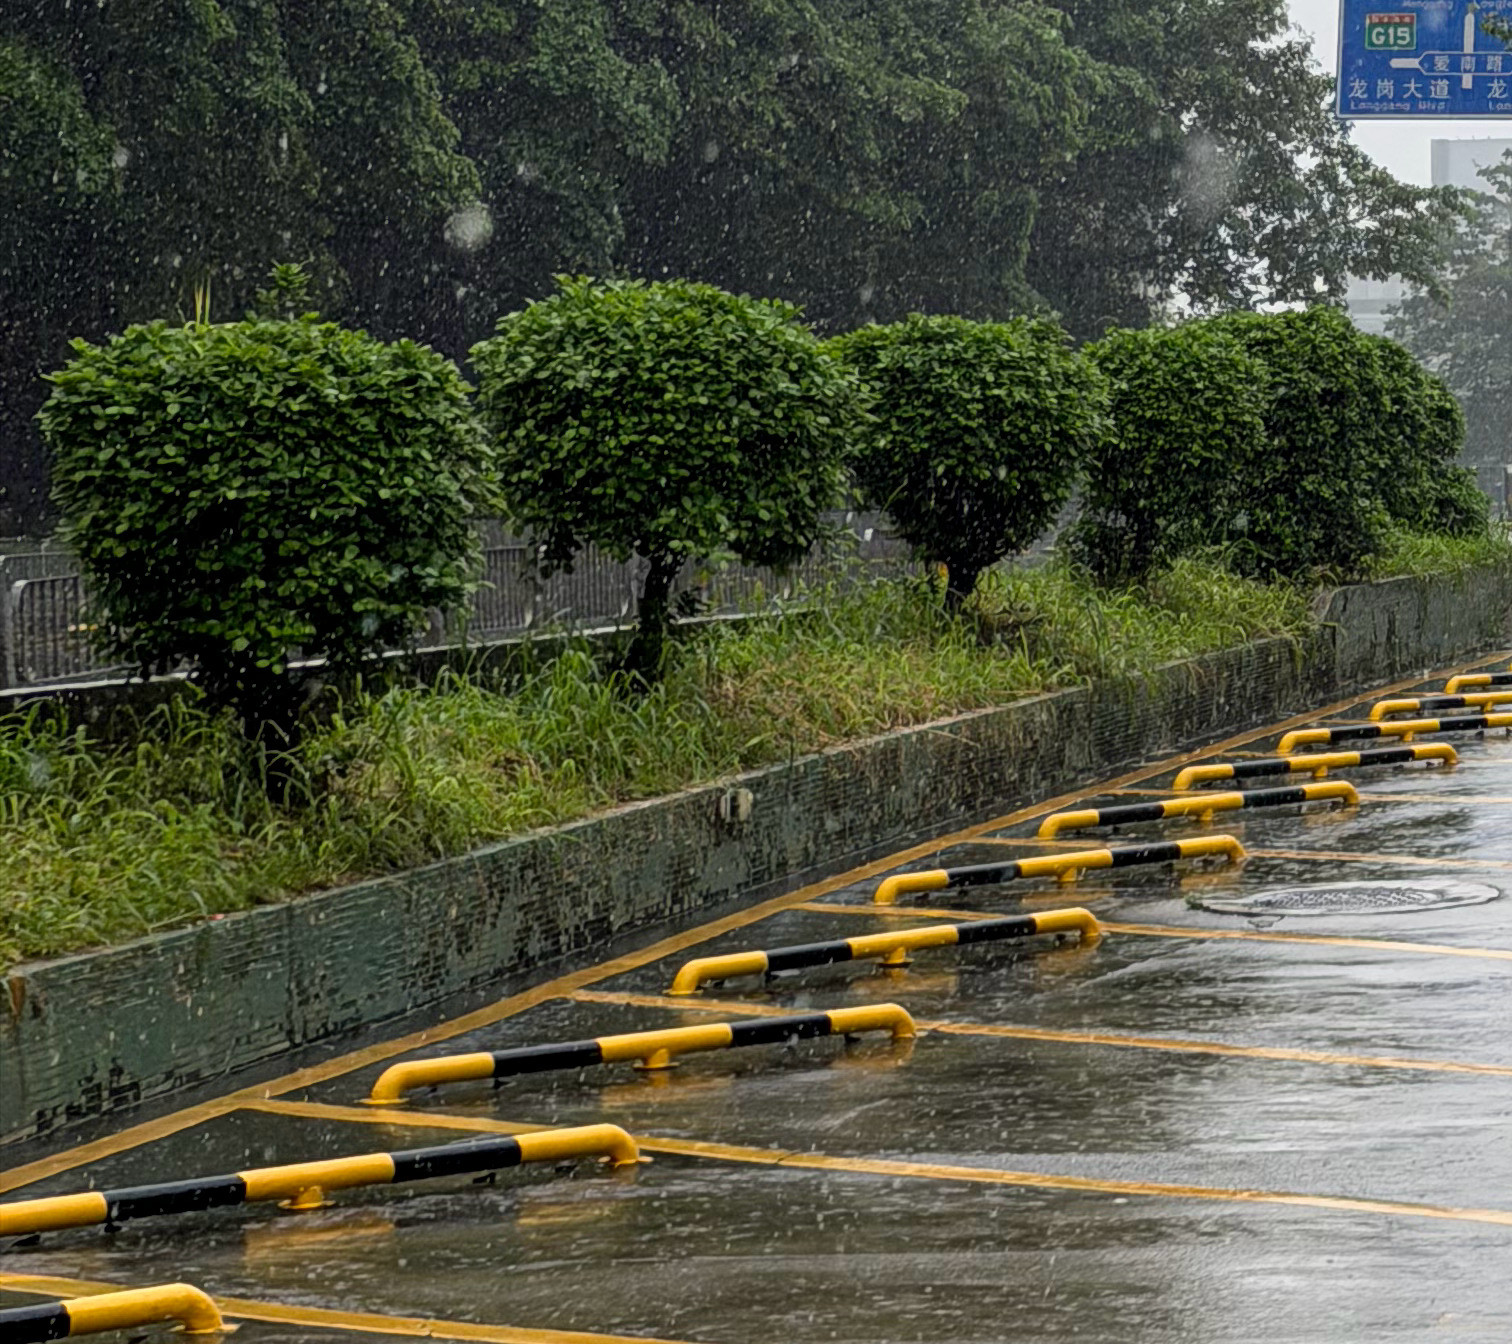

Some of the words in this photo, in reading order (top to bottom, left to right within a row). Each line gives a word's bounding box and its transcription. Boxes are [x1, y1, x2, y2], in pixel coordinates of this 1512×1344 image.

[1371, 26, 1411, 45] G15
[1348, 78, 1451, 100] 龙岗大道
